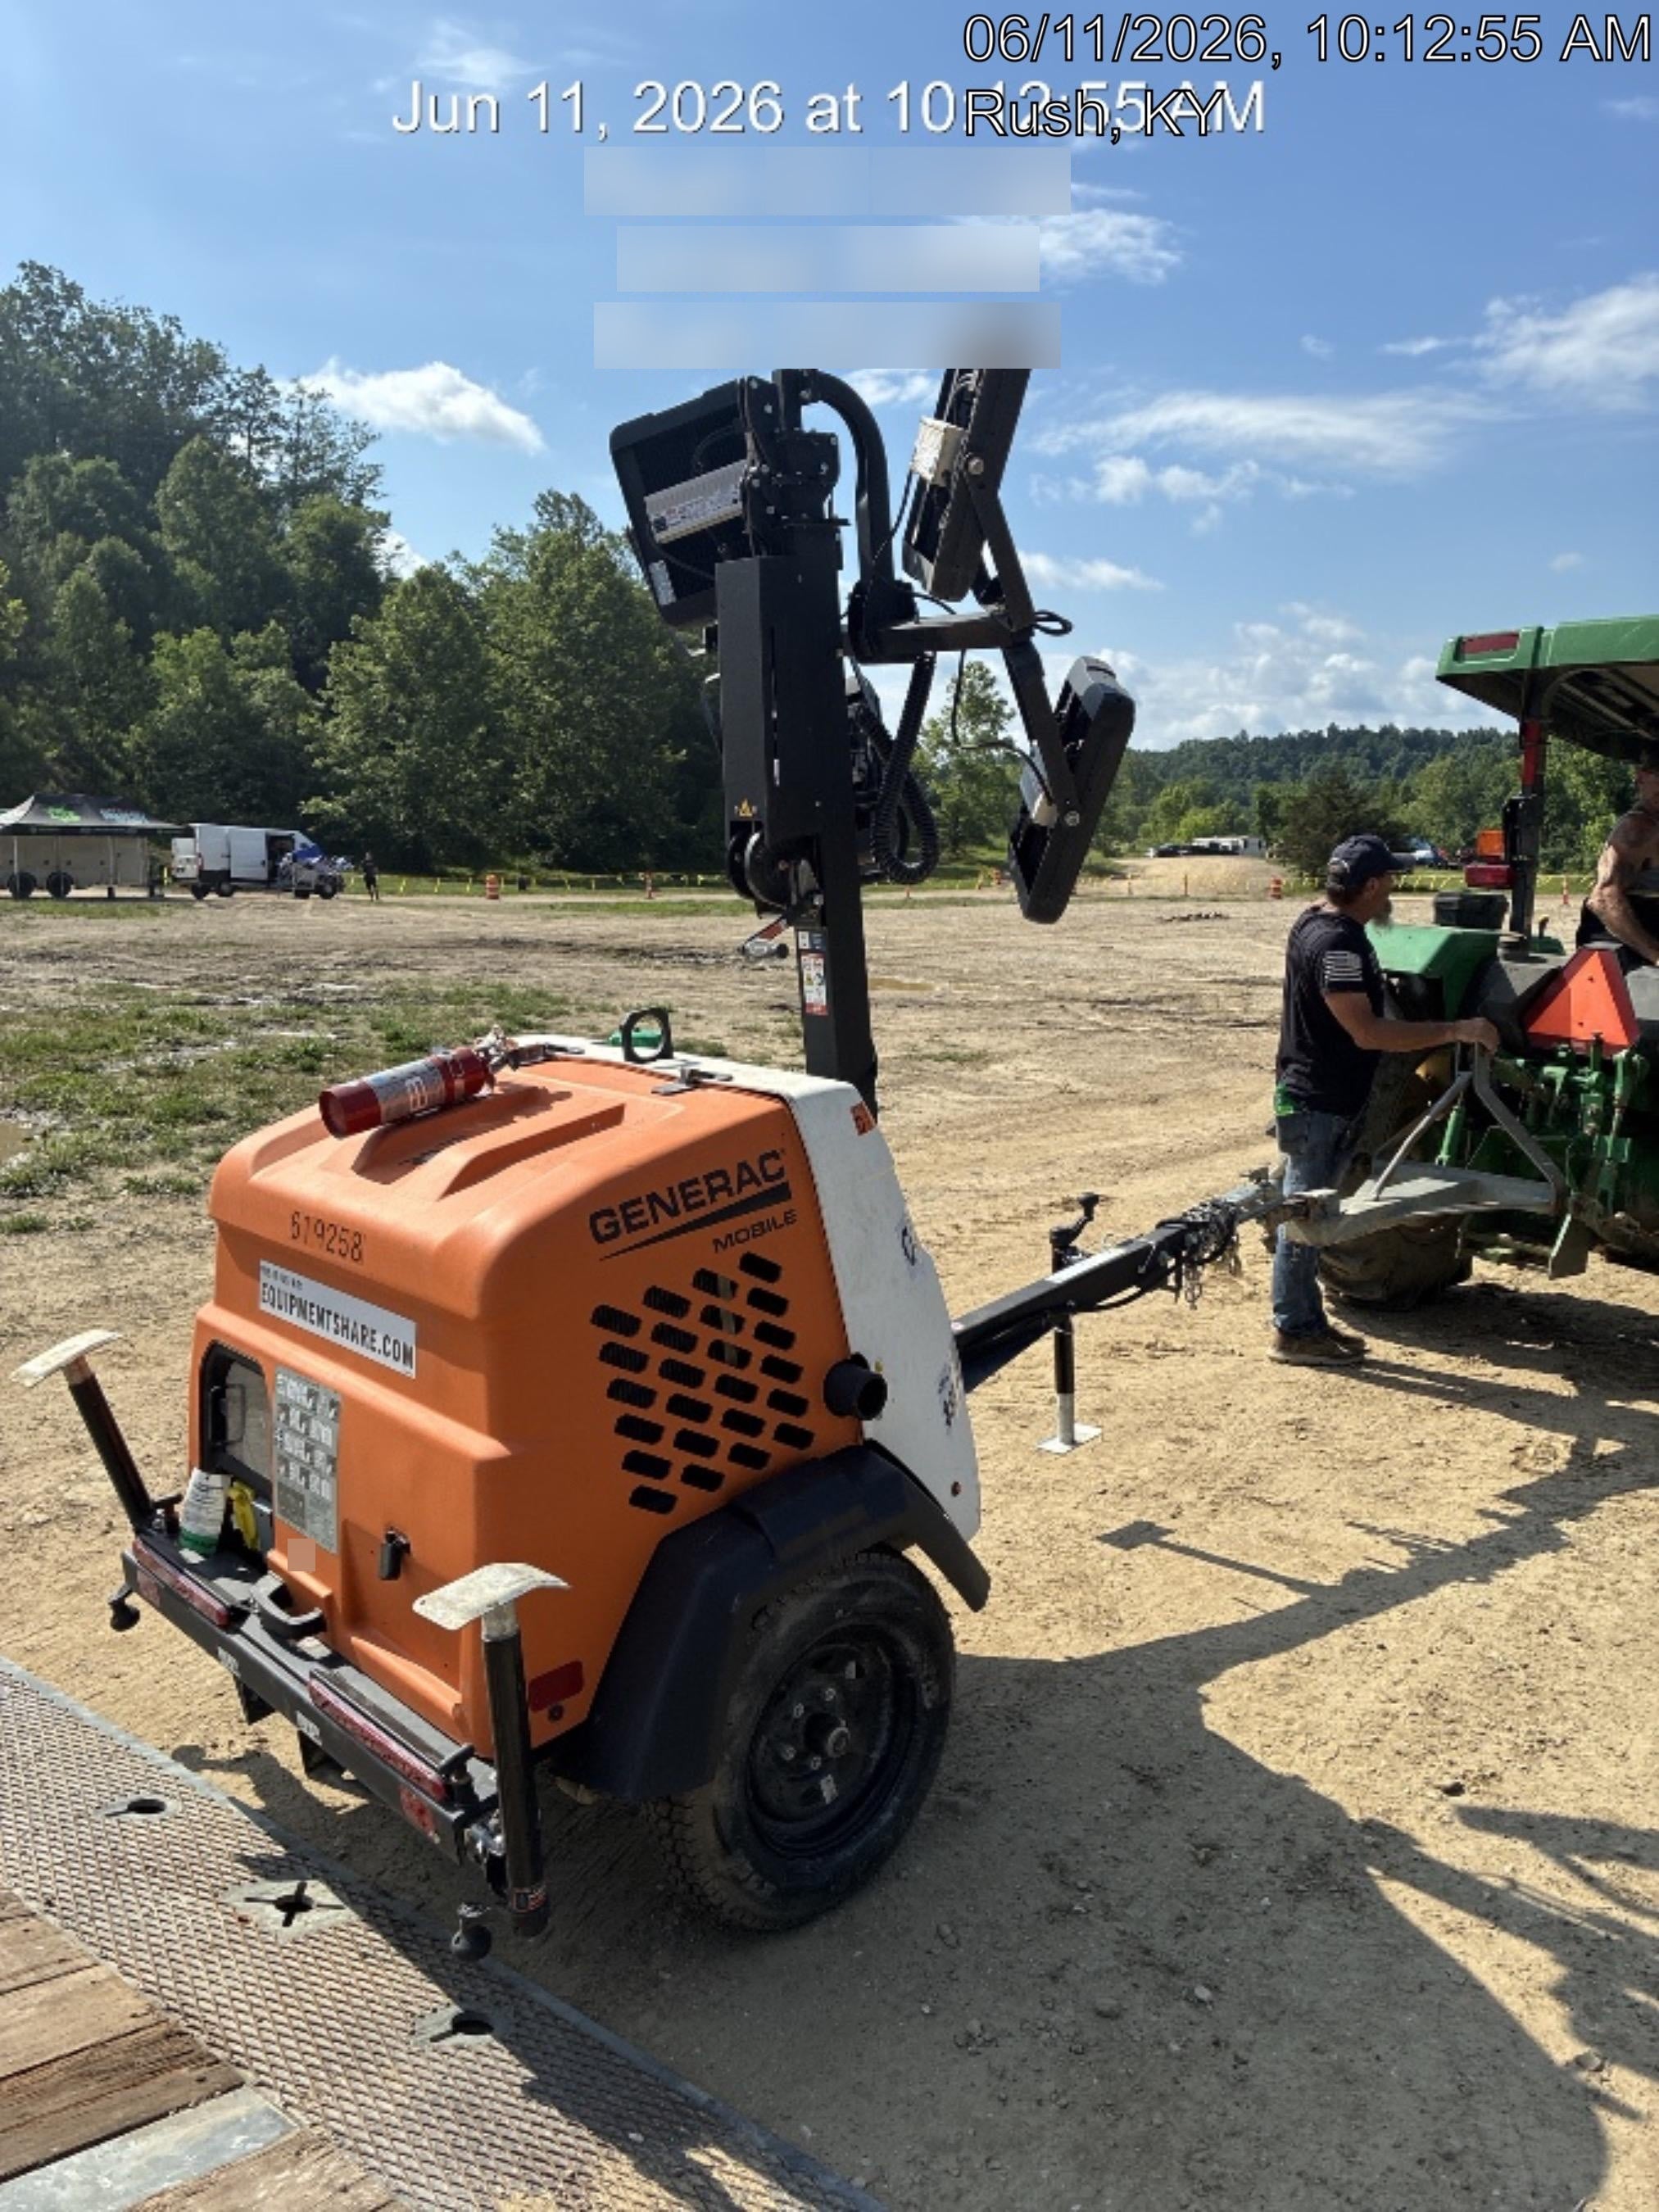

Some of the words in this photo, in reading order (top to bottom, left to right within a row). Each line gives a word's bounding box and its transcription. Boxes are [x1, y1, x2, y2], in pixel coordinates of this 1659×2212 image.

[589, 1149, 785, 1244] GENERAC
[713, 1208, 798, 1253] MOBILE
[261, 1282, 414, 1368] EQUIPMENTSHARE.COM
